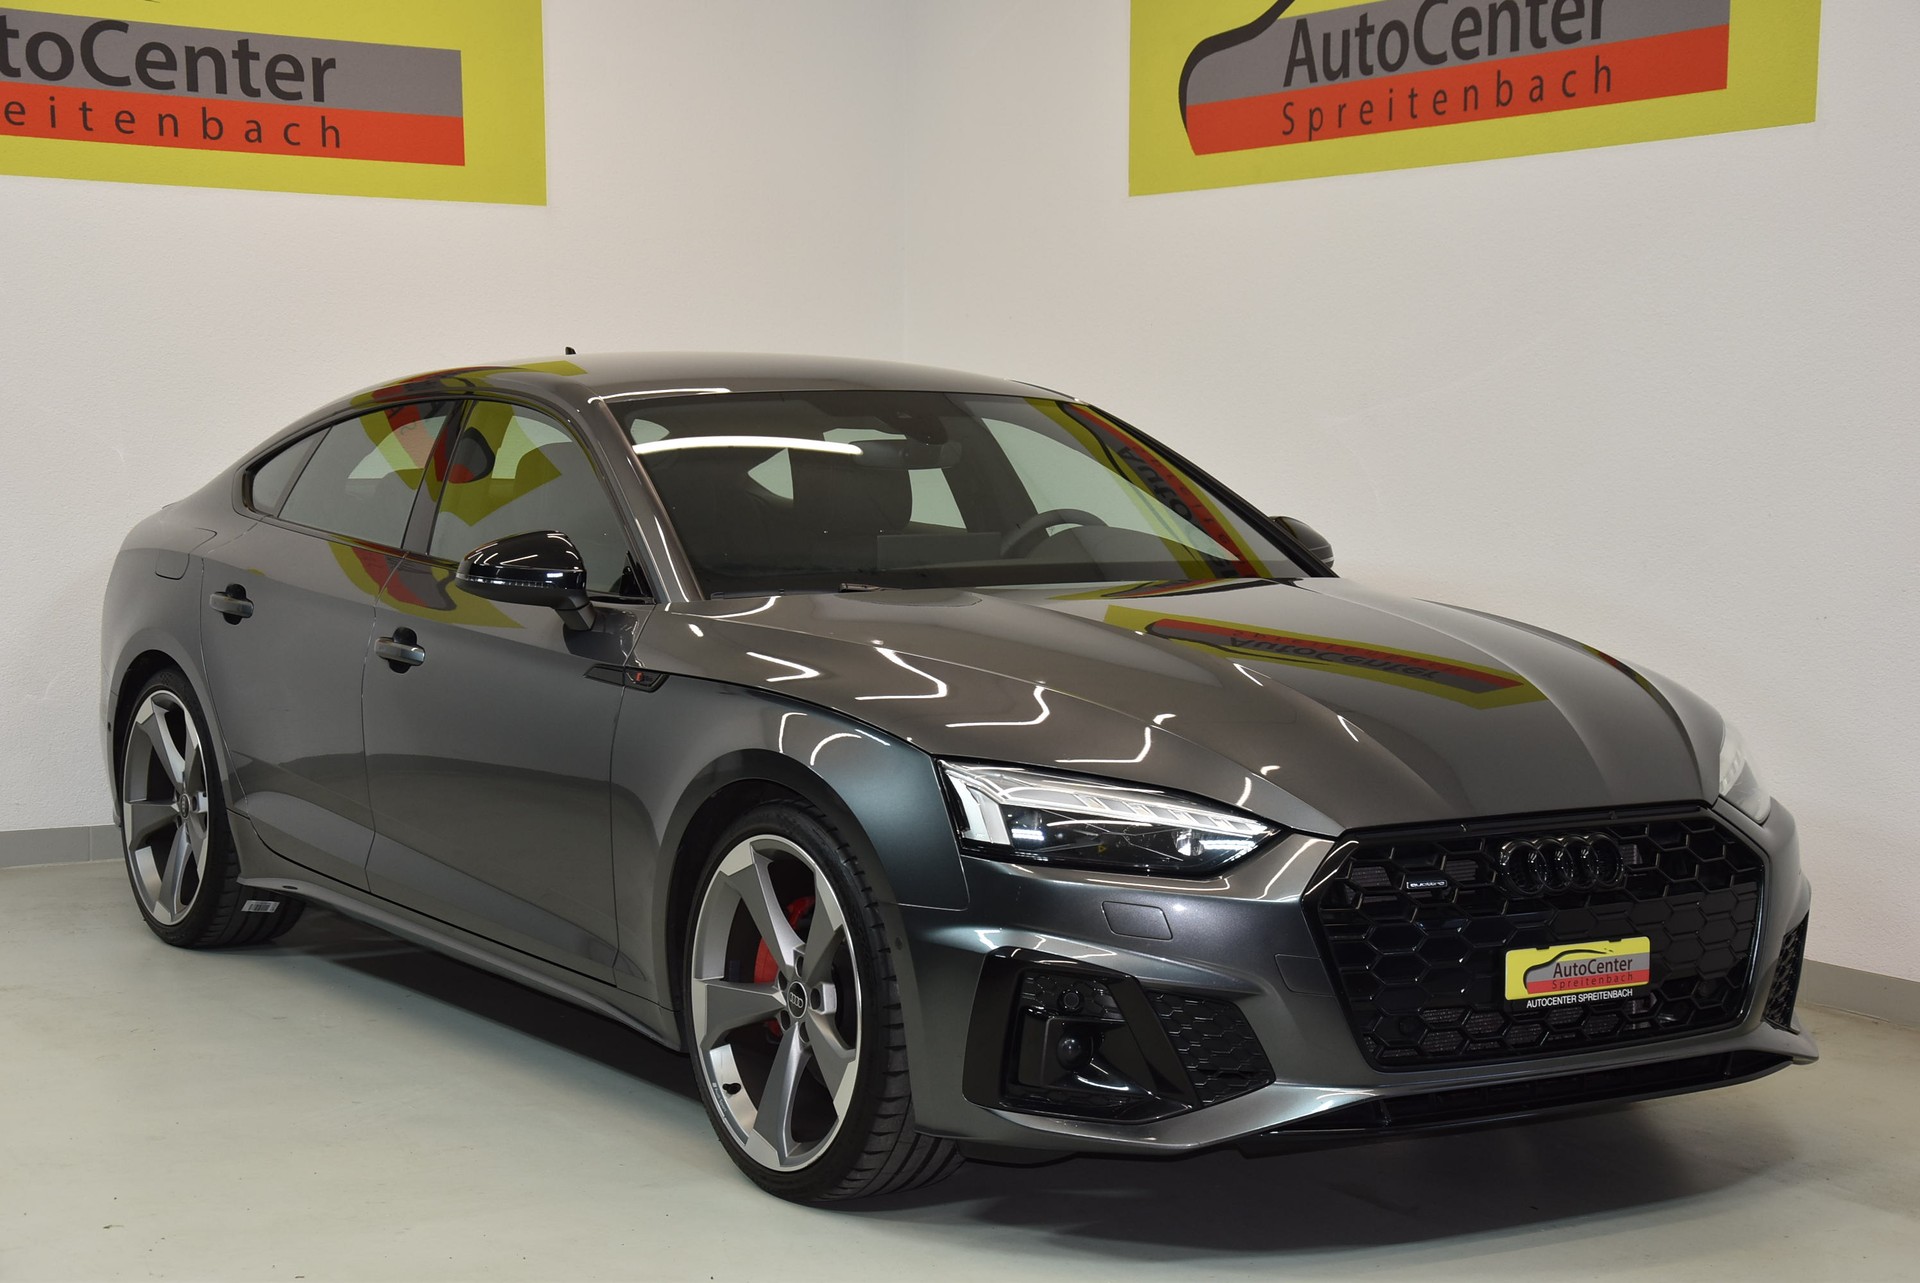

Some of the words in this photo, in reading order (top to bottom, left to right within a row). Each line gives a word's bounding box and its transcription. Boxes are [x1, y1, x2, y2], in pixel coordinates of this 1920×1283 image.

[0, 15, 337, 103] toCenter
[1282, 0, 1604, 88] AutoCenter
[4, 96, 342, 149] eitenbach
[1281, 55, 1612, 141] Spreitenbach
[1552, 958, 1633, 979] AutoCenter
[1552, 972, 1633, 990] Spreitenbach
[1526, 994, 1577, 1009] AUTOCENTER
[1578, 988, 1633, 1004] SPREITENBACH
